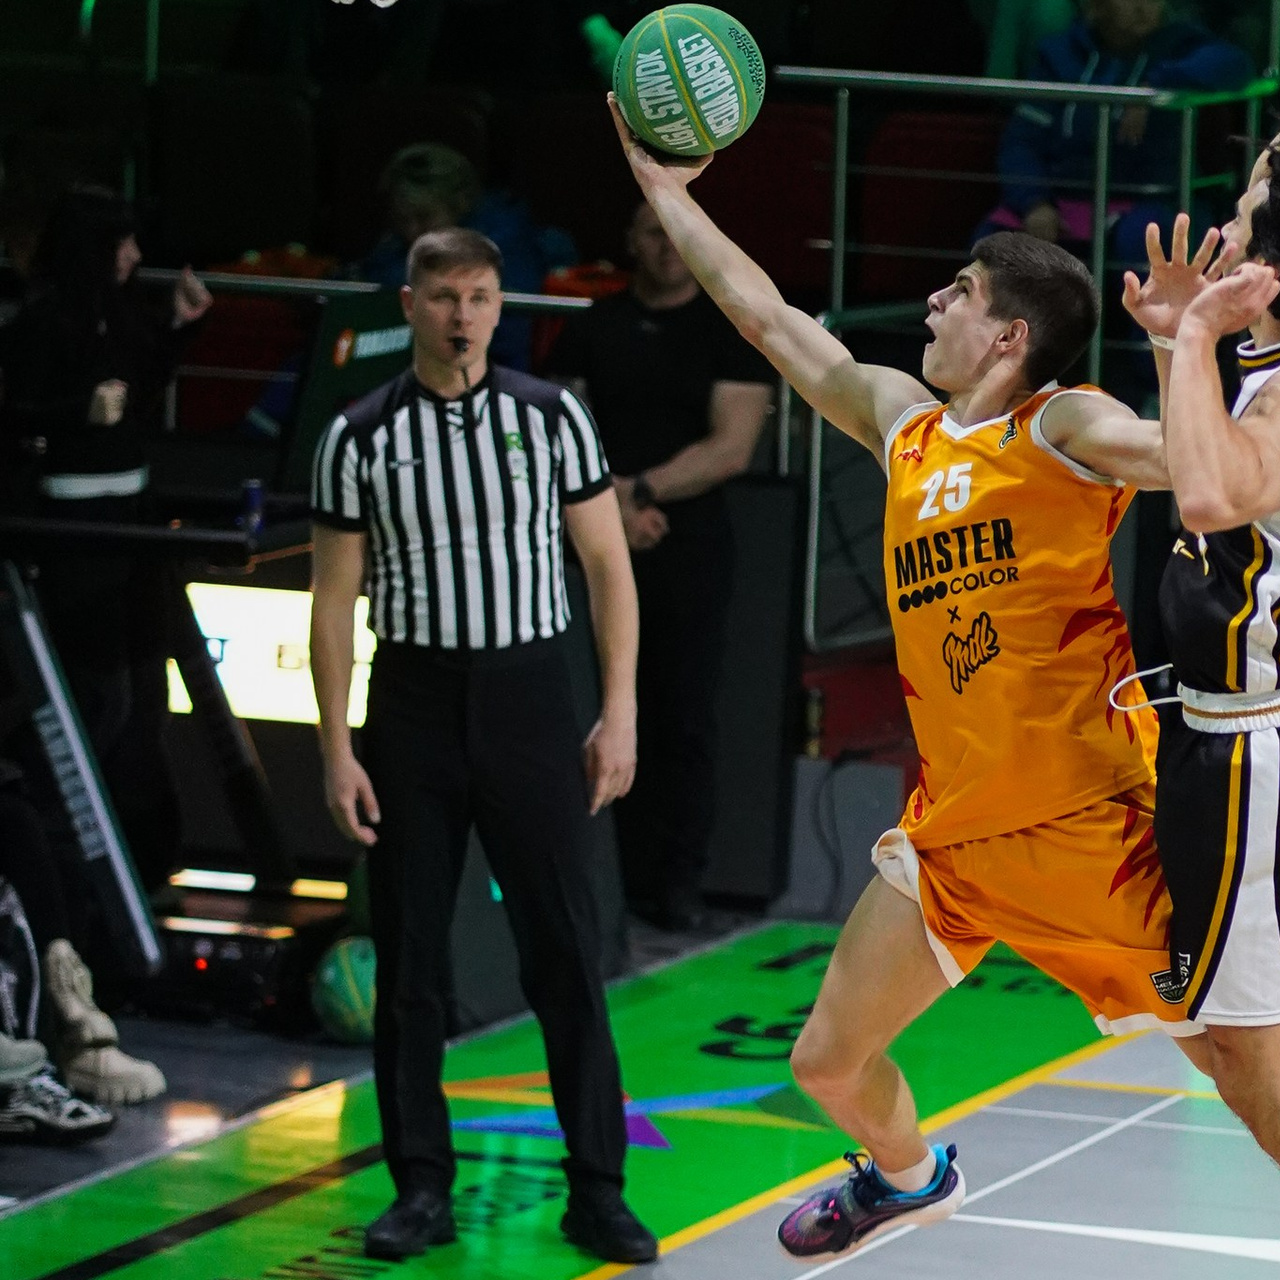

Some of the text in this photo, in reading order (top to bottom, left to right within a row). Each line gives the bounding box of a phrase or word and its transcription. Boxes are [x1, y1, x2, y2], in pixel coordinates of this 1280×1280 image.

[635, 48, 700, 151] LIGA STAVOK
[677, 32, 740, 139] MEDIA BASKET
[917, 462, 974, 521] 25
[893, 517, 1017, 590] MASTER
[949, 566, 1020, 595] COLOR
